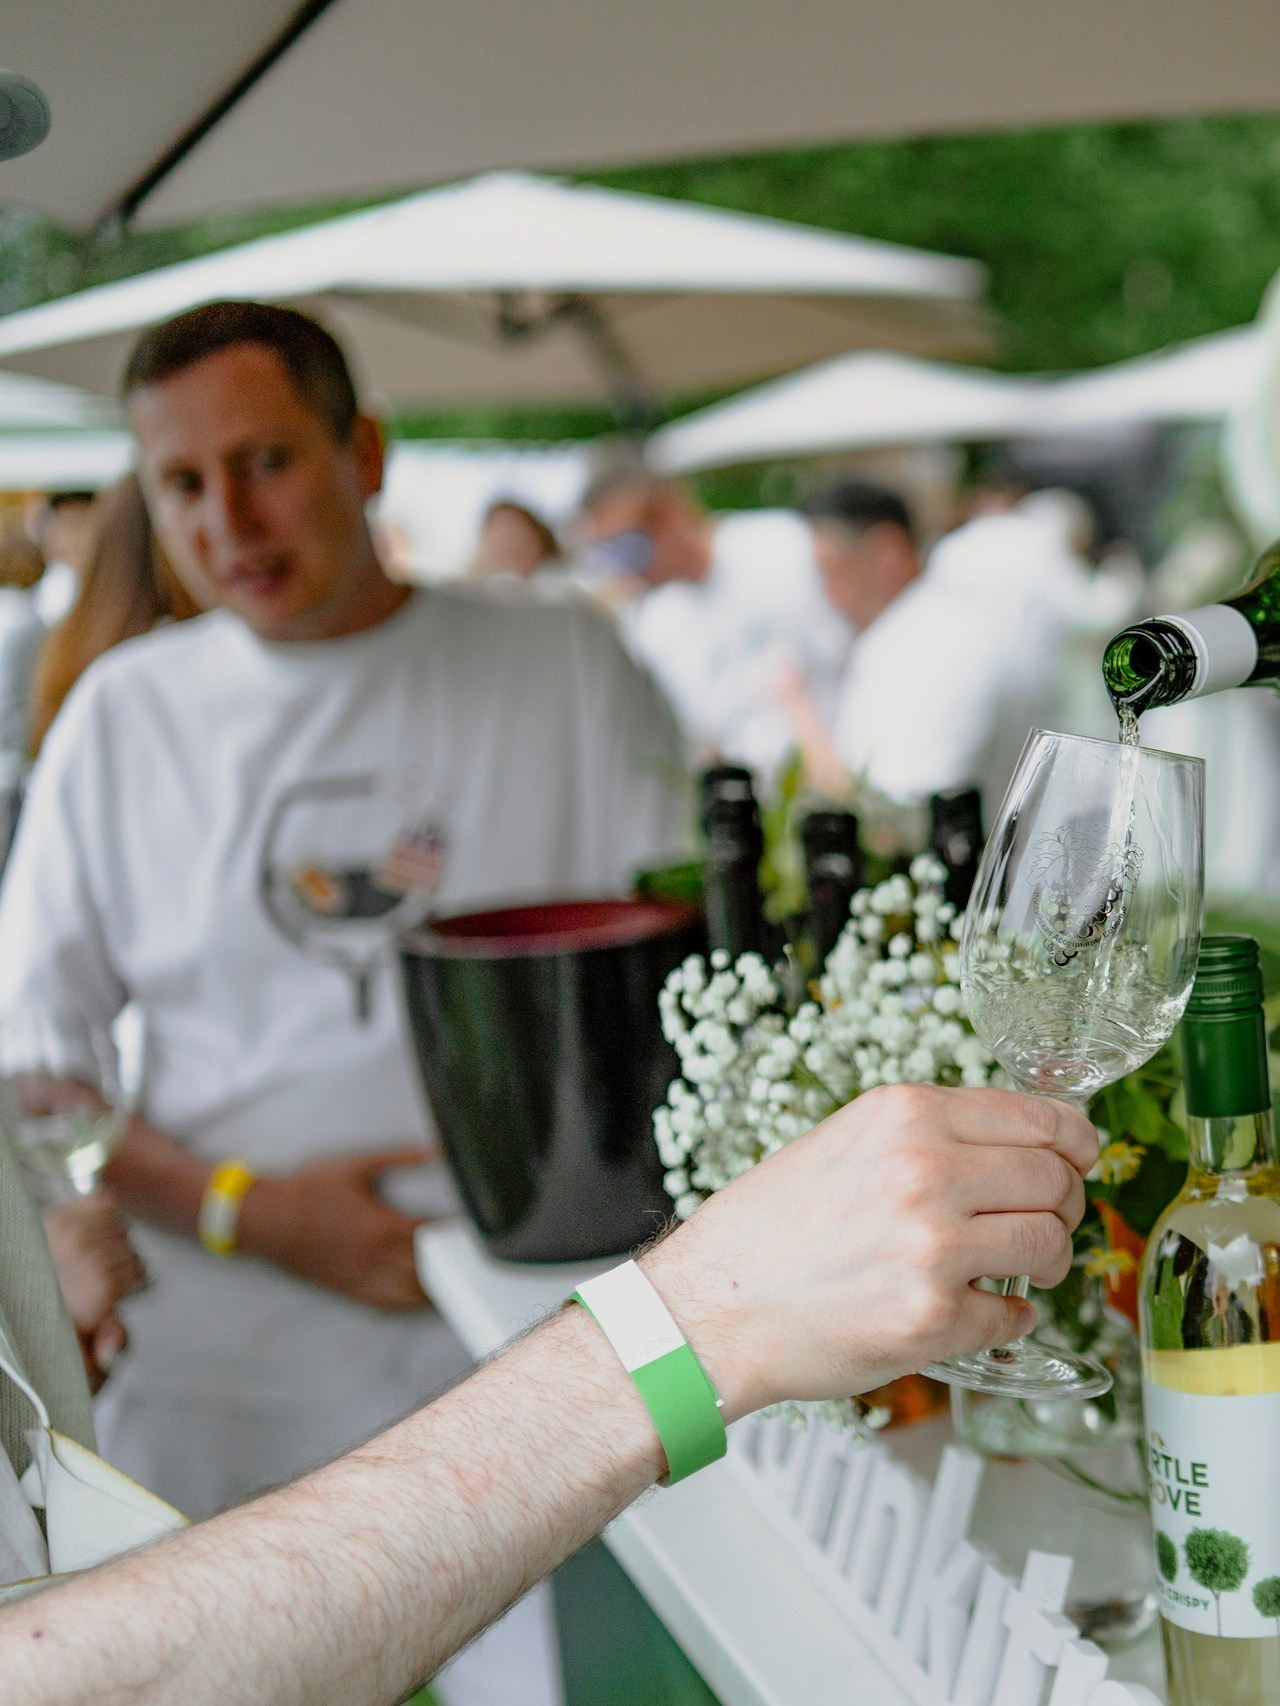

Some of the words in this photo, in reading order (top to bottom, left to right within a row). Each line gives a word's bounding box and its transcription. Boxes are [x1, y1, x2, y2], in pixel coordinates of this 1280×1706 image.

[1151, 1446, 1209, 1488] RTLE
[1150, 1481, 1202, 1517] OVE
[1167, 1588, 1209, 1612] CRISPY
